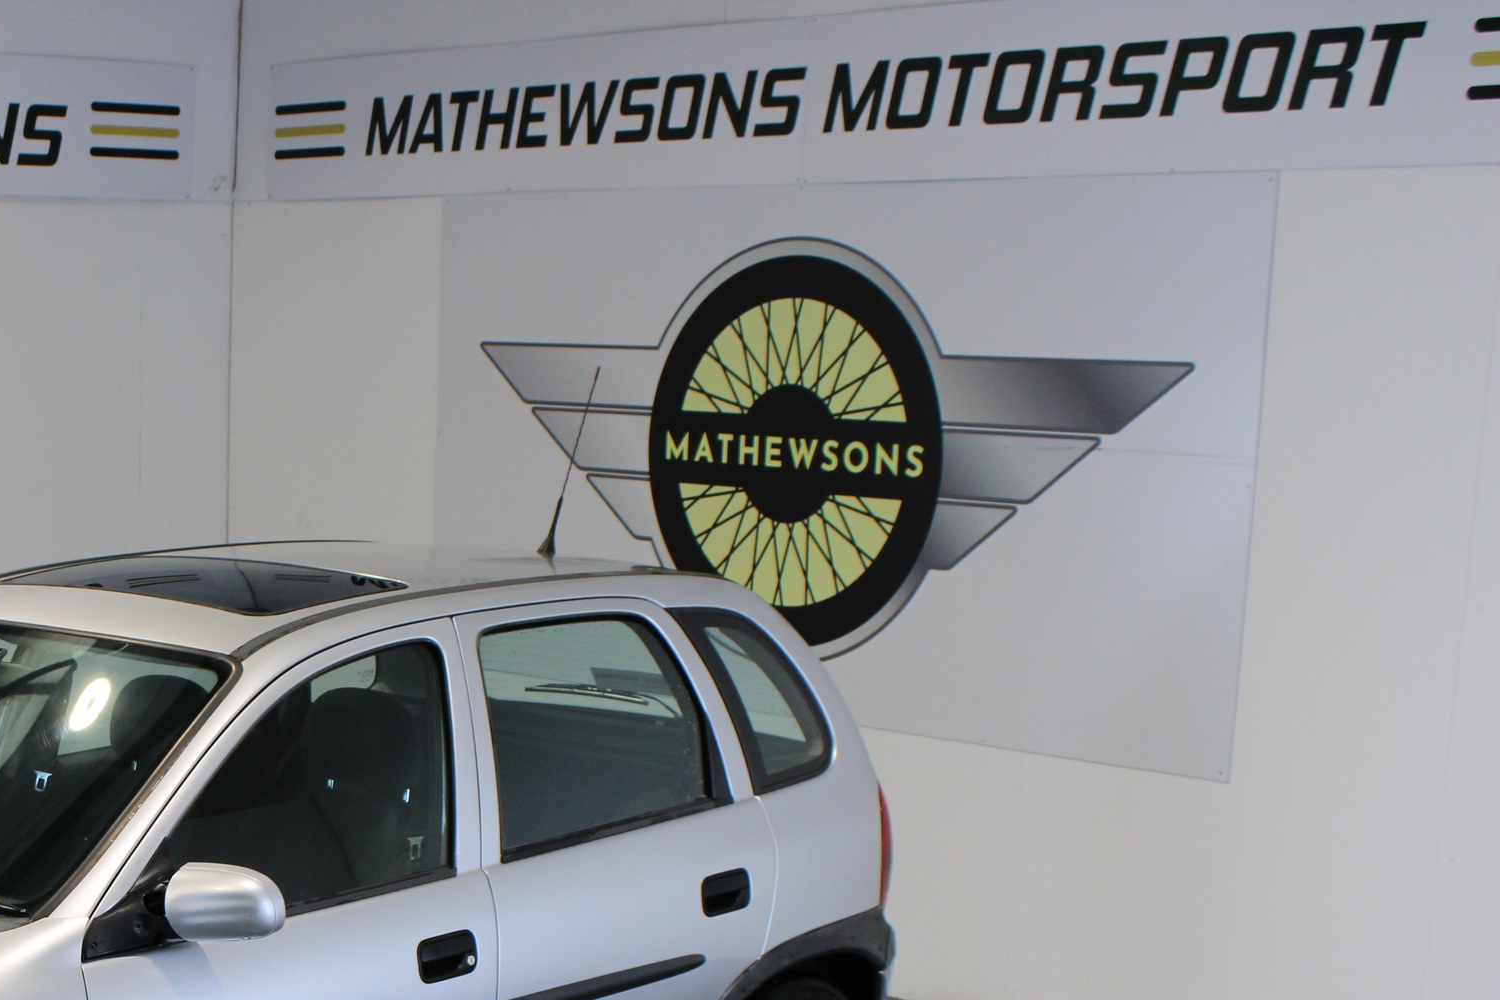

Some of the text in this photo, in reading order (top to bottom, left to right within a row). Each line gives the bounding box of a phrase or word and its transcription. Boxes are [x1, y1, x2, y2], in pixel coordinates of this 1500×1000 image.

[365, 21, 1427, 156] MATHEWSONS MOTORSPORT
[665, 431, 924, 478] MATHEWSONS
